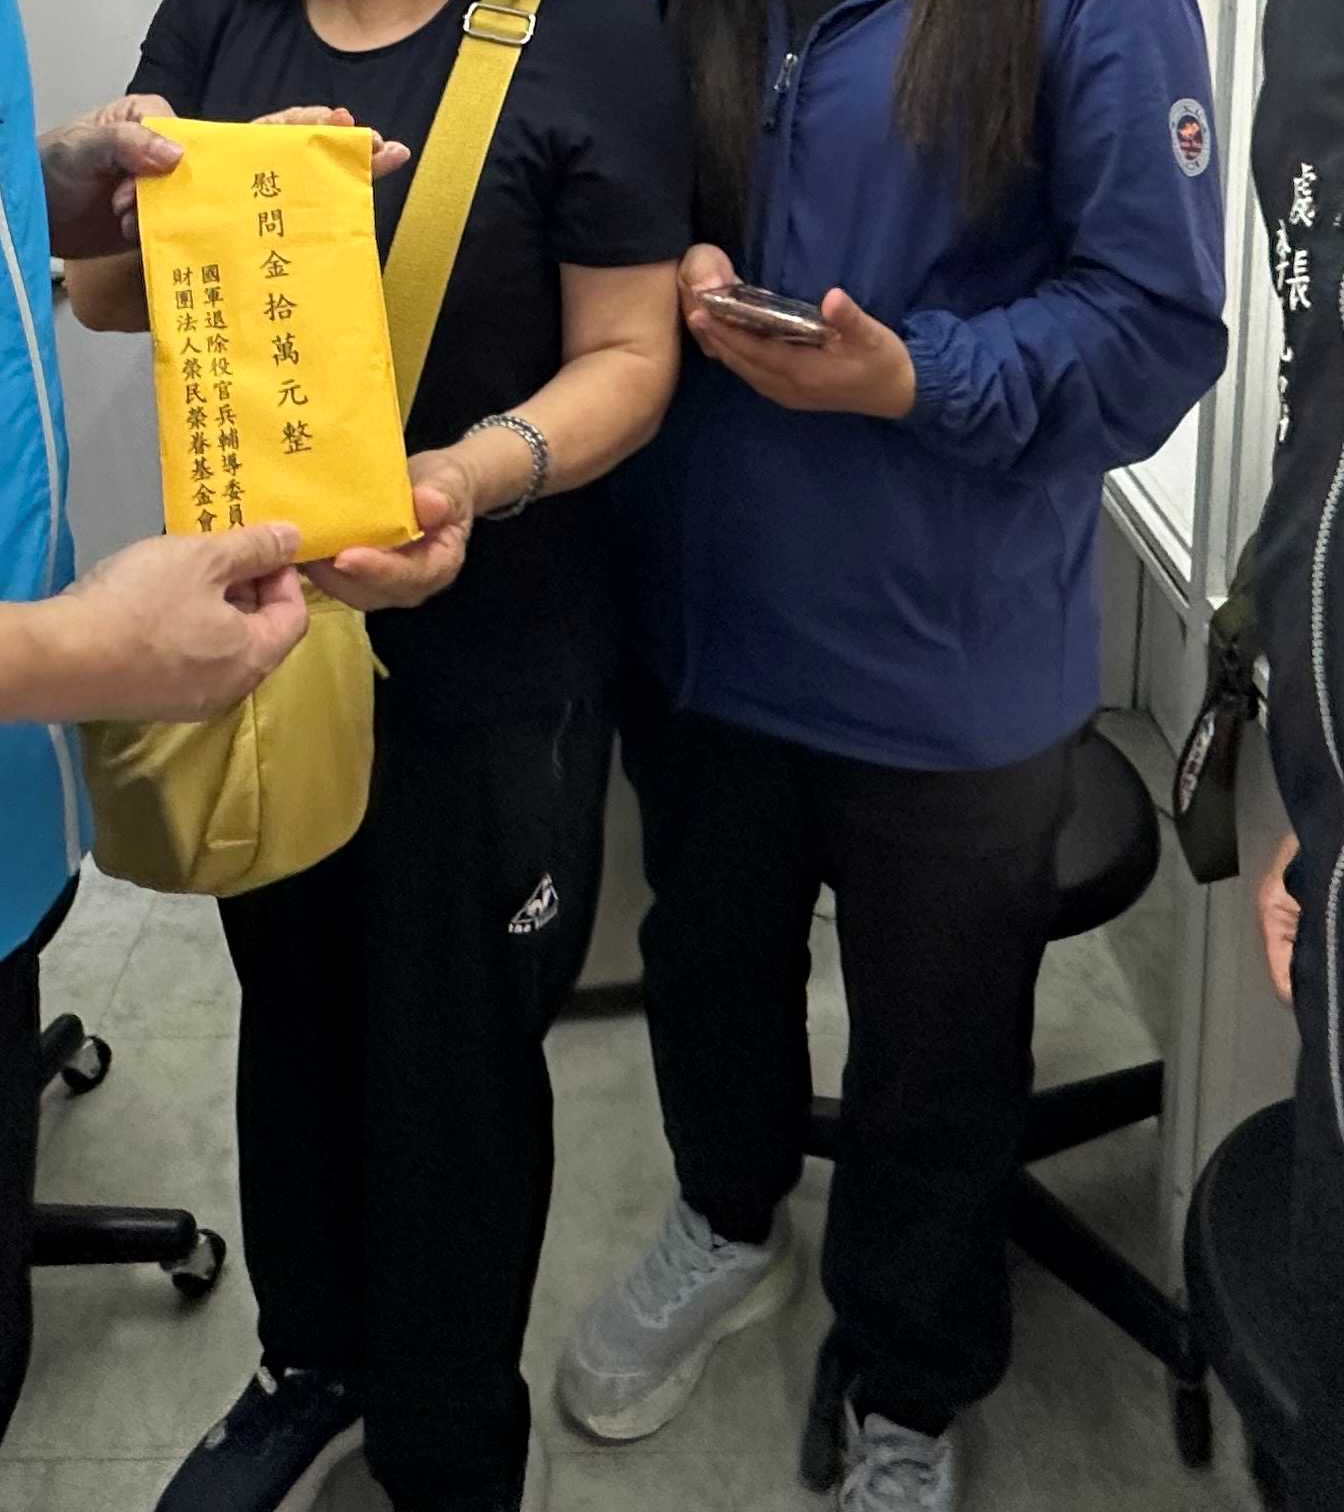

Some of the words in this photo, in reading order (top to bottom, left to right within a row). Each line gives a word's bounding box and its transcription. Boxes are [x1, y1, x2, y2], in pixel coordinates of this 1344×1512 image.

[250, 170, 313, 455] 慰問金拾萬元整
